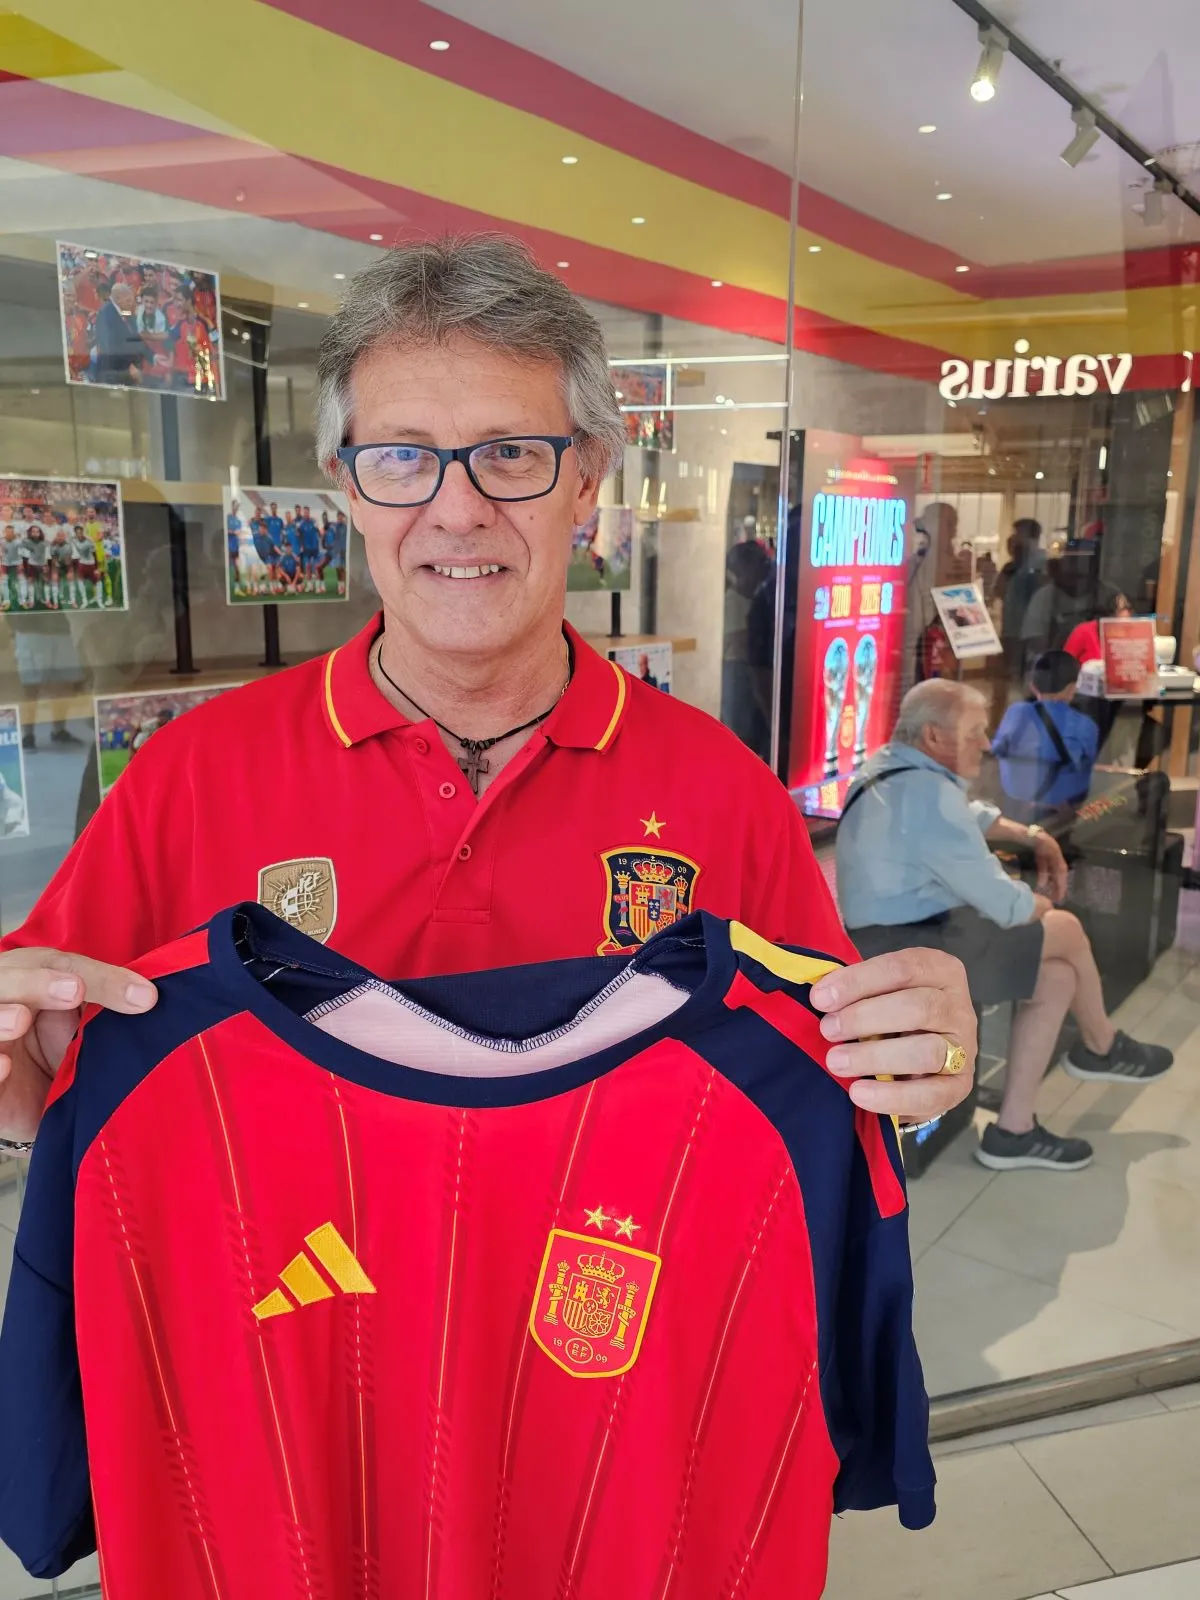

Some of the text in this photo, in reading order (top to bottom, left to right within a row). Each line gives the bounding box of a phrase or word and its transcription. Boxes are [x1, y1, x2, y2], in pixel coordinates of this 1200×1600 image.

[811, 492, 906, 567] CAMPEONES
[618, 857, 628, 866] 19
[553, 1338, 563, 1347] 19
[595, 1355, 608, 1364] 09
